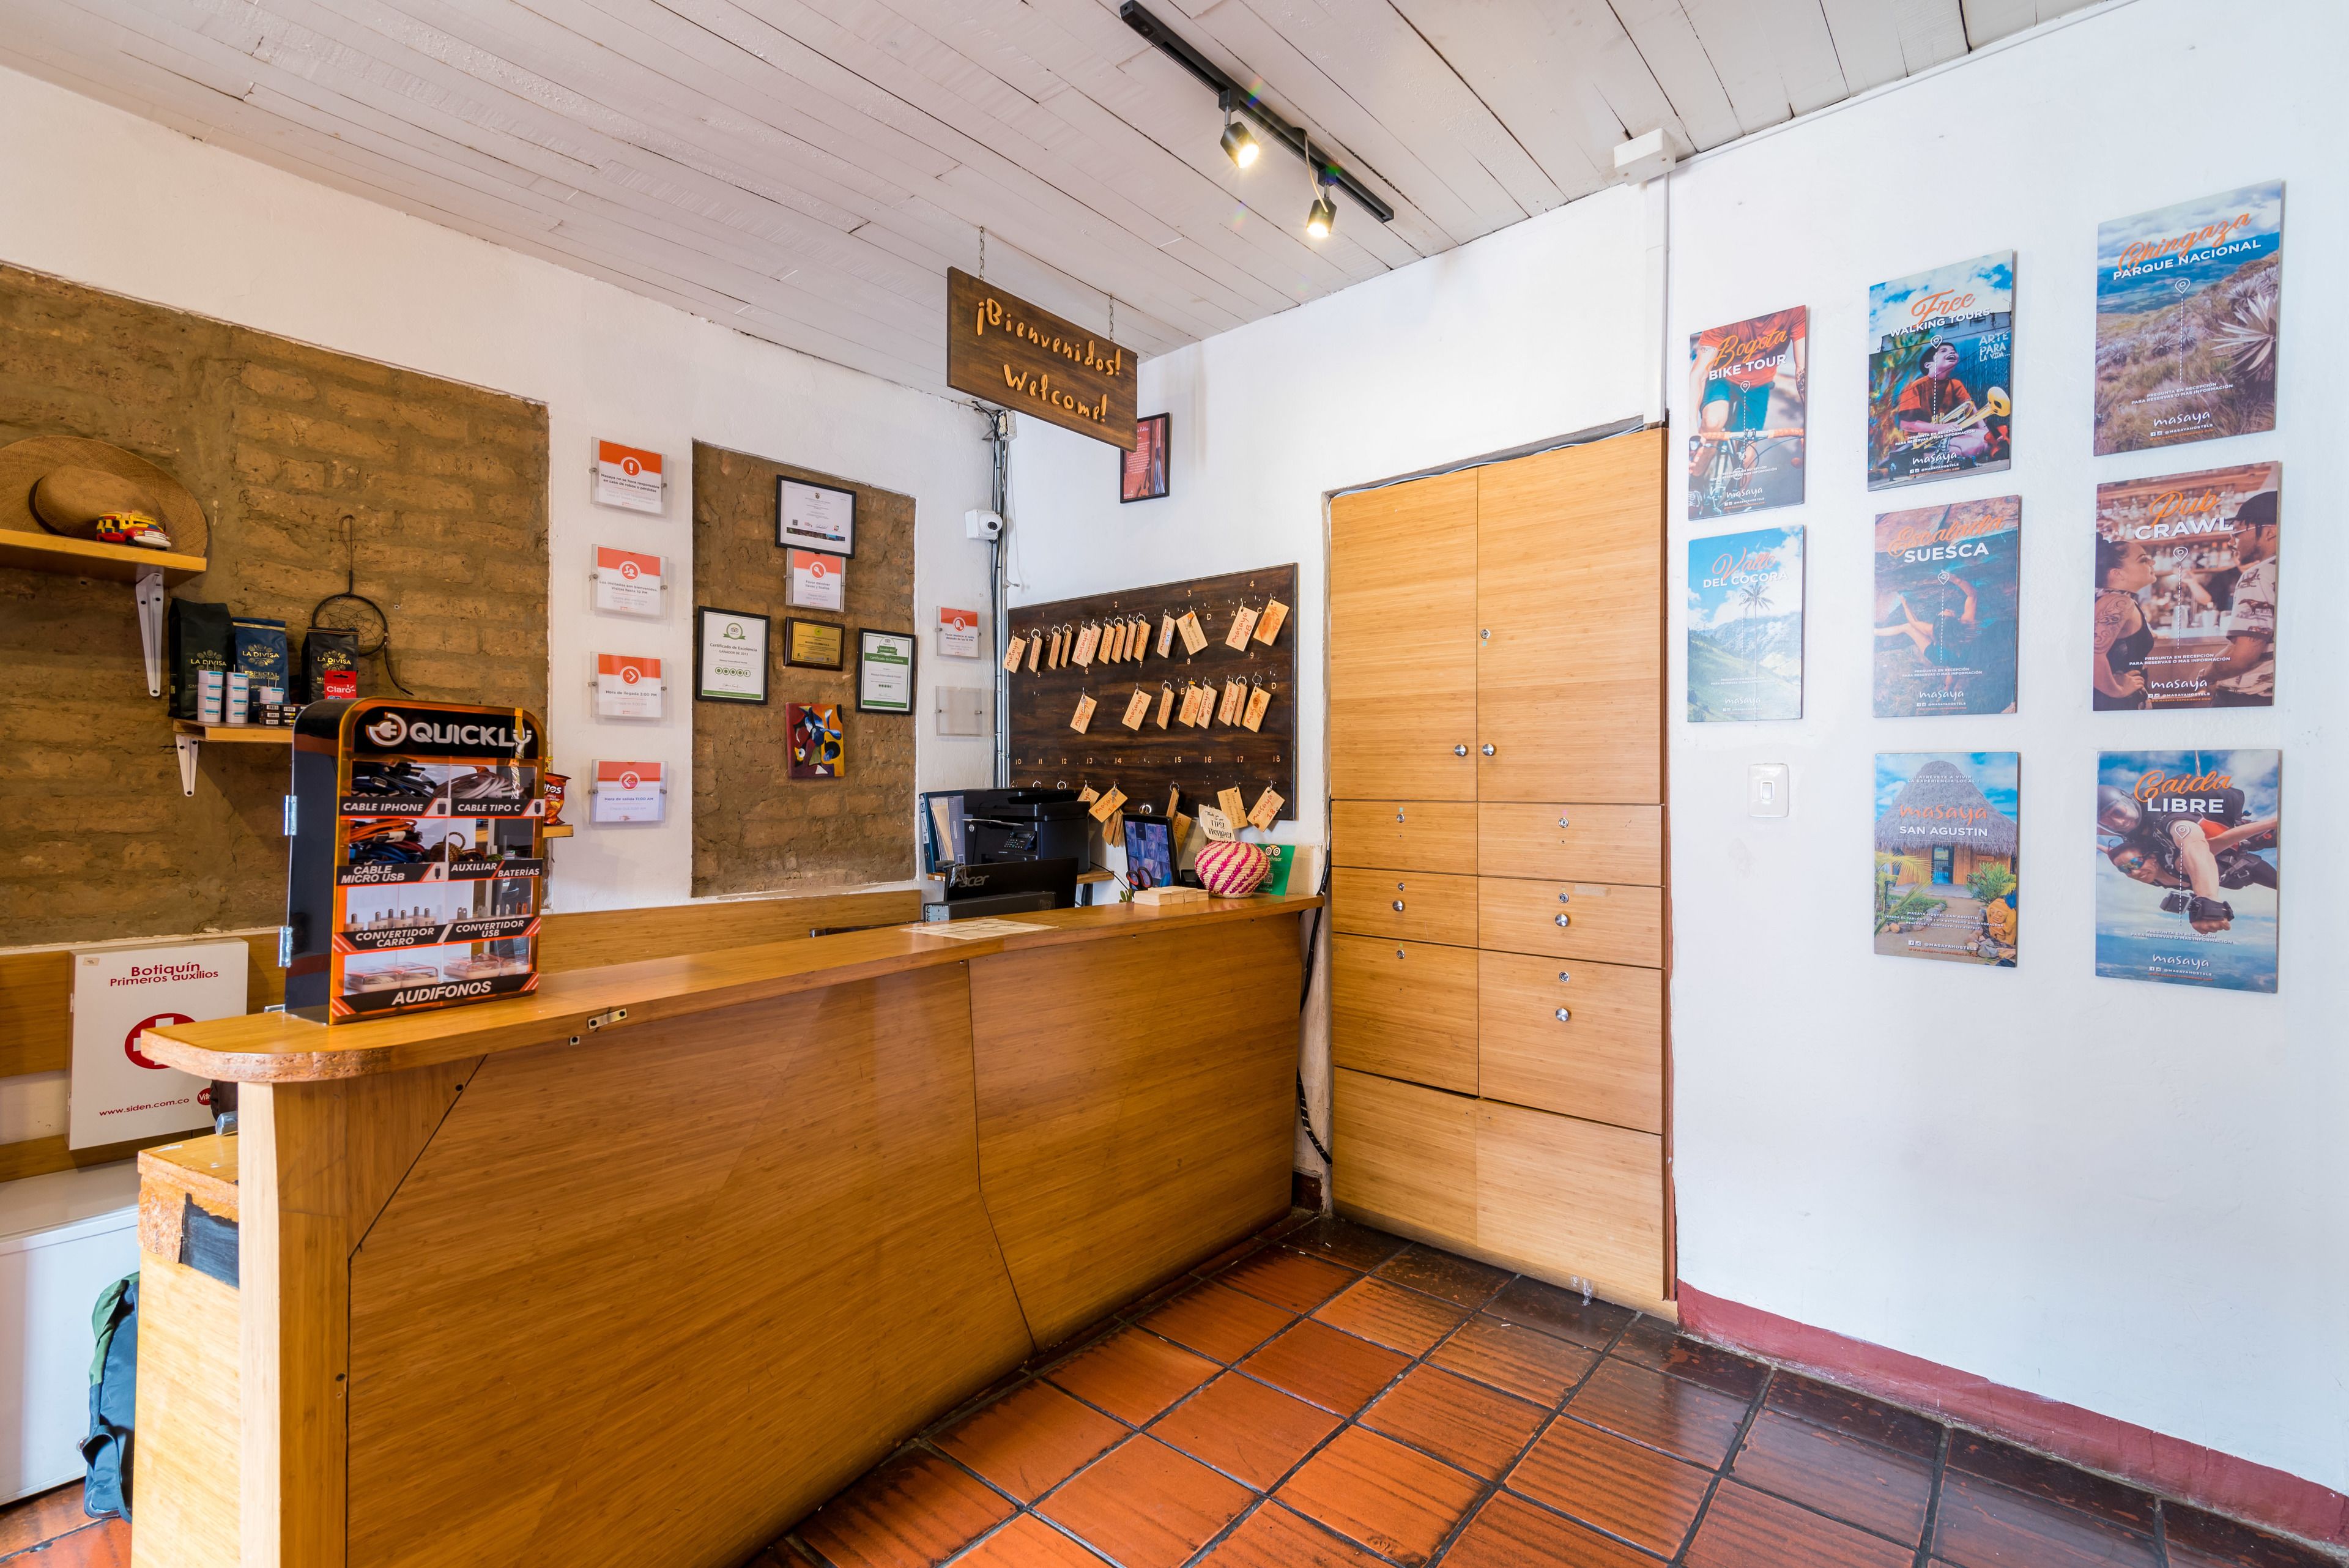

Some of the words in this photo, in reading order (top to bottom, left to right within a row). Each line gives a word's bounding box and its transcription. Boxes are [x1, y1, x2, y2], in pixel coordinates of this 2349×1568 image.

[2118, 213, 2252, 273] Chingaza
[2113, 259, 2173, 280] PARQUE
[2178, 240, 2262, 265] NACIONAL
[1911, 289, 1976, 328] Free
[1890, 318, 1945, 337] WALKING
[1949, 308, 1991, 324] TOURS
[976, 297, 1121, 376] ¡Bienvenidos!
[1979, 332, 2009, 346] ARTE
[1980, 342, 2006, 355] PARA
[1709, 364, 1741, 381] BIKE
[1745, 354, 1787, 373] TOUR
[1003, 364, 1107, 422] Welcome!
[2154, 412, 2210, 426] masaya
[1912, 452, 1957, 464] masaya
[1726, 488, 1763, 499] masaya
[2149, 490, 2222, 529] Pub
[1888, 514, 2006, 557] Escalada
[2135, 518, 2233, 540] CRAWL
[1904, 542, 1989, 563] SUESCA
[1712, 547, 1775, 580] Valle
[1703, 578, 1727, 588] DEL
[1731, 571, 1788, 585] COCORA
[1231, 612, 1248, 644] masaya
[1007, 642, 1018, 666] masaya
[1077, 633, 1088, 660] masaya
[2151, 679, 2207, 691] masaya
[1725, 697, 1761, 705] masaya
[1920, 690, 1964, 700] masaya
[1128, 695, 1143, 723] masaya
[1183, 690, 1195, 719] masaya
[409, 722, 532, 751] QUICKLY
[2134, 770, 2233, 803] Caida
[343, 803, 378, 811] CABLE
[380, 803, 423, 812] IPHONE
[1253, 795, 1273, 820] masaya
[2147, 798, 2224, 813] LIBRE
[1899, 804, 1987, 826] masaya
[1899, 826, 1925, 835] SAN
[1930, 827, 1987, 836] AGUSTIN
[354, 865, 392, 875] CABLE
[451, 862, 497, 872] AUXILIAR
[498, 867, 540, 878] BATERÍAS
[341, 874, 378, 885] MICRO
[381, 872, 405, 882] USB
[355, 927, 434, 942] CONVERTIDOR
[456, 920, 524, 933] CONVERTIDOR
[481, 929, 500, 938] USB
[377, 937, 415, 948] CARRO
[131, 962, 200, 977] Botiquín
[2153, 954, 2210, 970] masaya
[110, 975, 167, 987] Primeros
[172, 970, 218, 982] auxilios
[392, 981, 492, 1006] AUDIFONOS
[100, 1098, 189, 1116] www.siden.com.co
